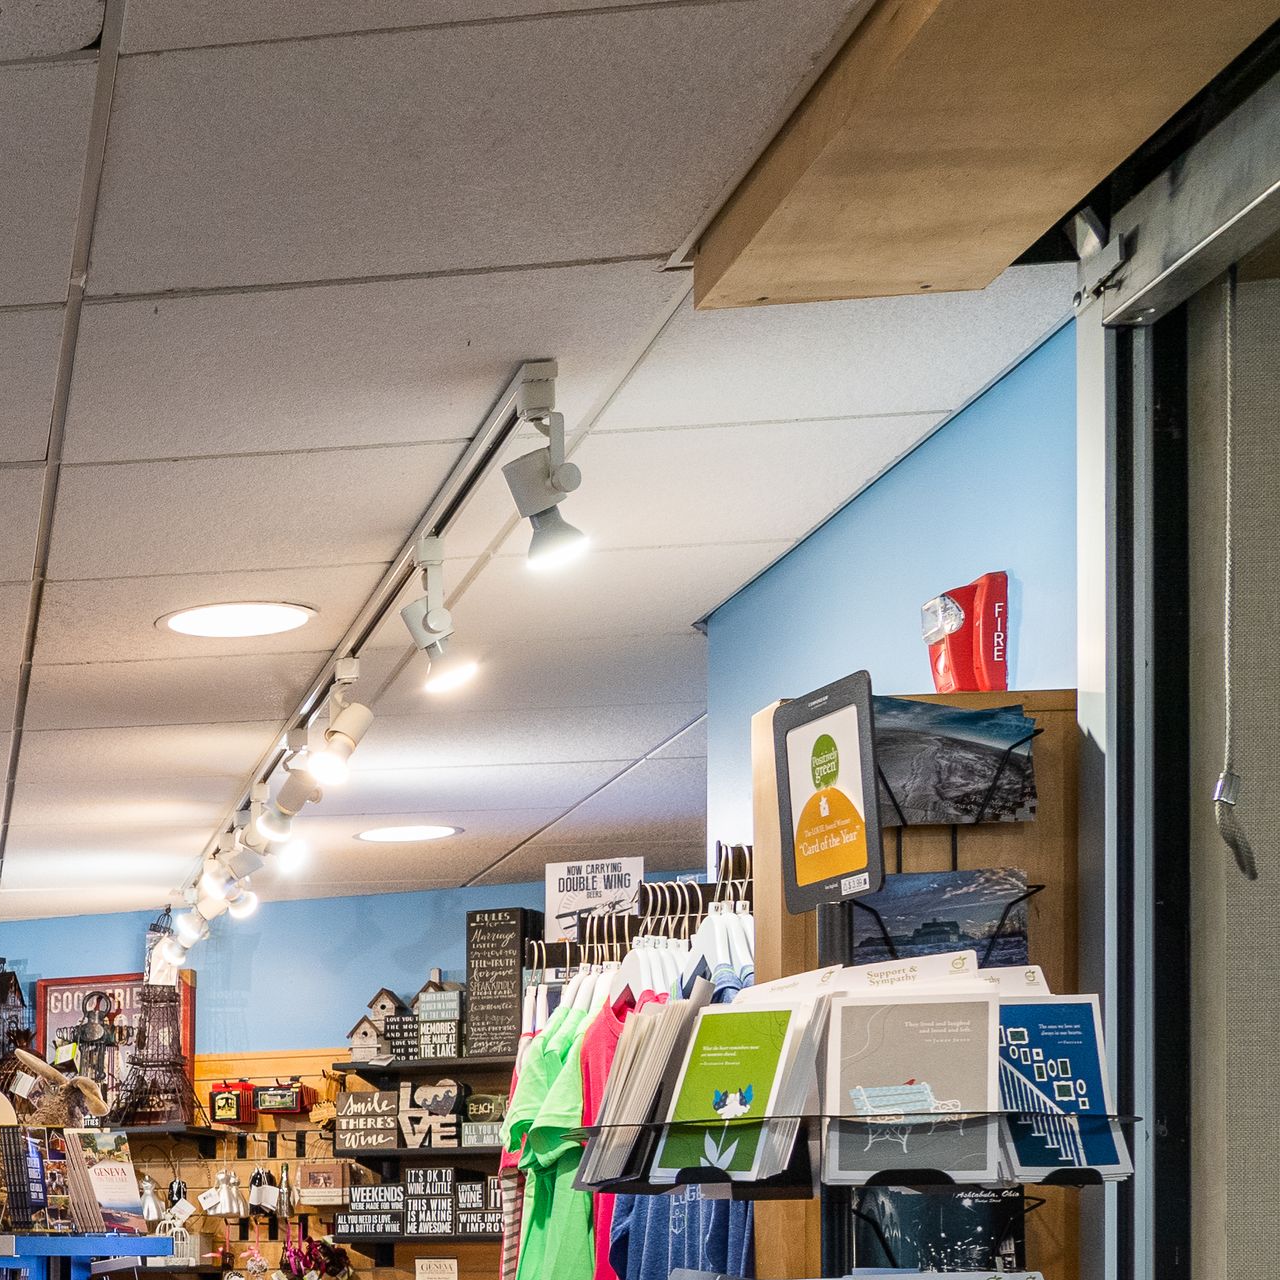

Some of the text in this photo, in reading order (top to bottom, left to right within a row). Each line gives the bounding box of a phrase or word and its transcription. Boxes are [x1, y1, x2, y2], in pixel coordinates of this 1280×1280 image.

[994, 602, 1004, 661] FIRE
[814, 762, 836, 784] green
[820, 835, 840, 850] of the
[567, 862, 622, 876] NOW CARRYING
[558, 873, 631, 892] DOUBLE WING
[587, 891, 602, 899] BEERS
[475, 912, 510, 922] RULES
[471, 930, 516, 947] Marriage
[866, 966, 908, 979] Support
[868, 974, 918, 986] Sympathy
[421, 1022, 456, 1034] MEMORIES
[421, 1034, 456, 1044] ARE MADE AT
[421, 1045, 456, 1057] THE LAKE
[469, 1102, 495, 1114] BEACH
[340, 1116, 395, 1129] THERE'S
[464, 1124, 491, 1134] ALL YOU
[340, 1130, 394, 1147] Wine
[94, 1167, 127, 1177] GENEVA
[407, 1170, 451, 1182] IT'S OK TO
[351, 1186, 404, 1202] WEEKENDS
[407, 1183, 451, 1195] WINE A LITTLE
[1001, 1190, 1019, 1198] Ohio
[459, 1192, 482, 1203] WINE
[408, 1199, 452, 1211] THIS WINE
[338, 1215, 377, 1224] ALL YOU NEED IS
[408, 1211, 452, 1222] IS MAKING
[460, 1214, 481, 1223] WINE
[338, 1225, 349, 1233] AND
[356, 1224, 376, 1232] BOTTLE
[377, 1224, 384, 1232] OF
[385, 1223, 400, 1232] WINE
[407, 1222, 452, 1233] ME AWESOME
